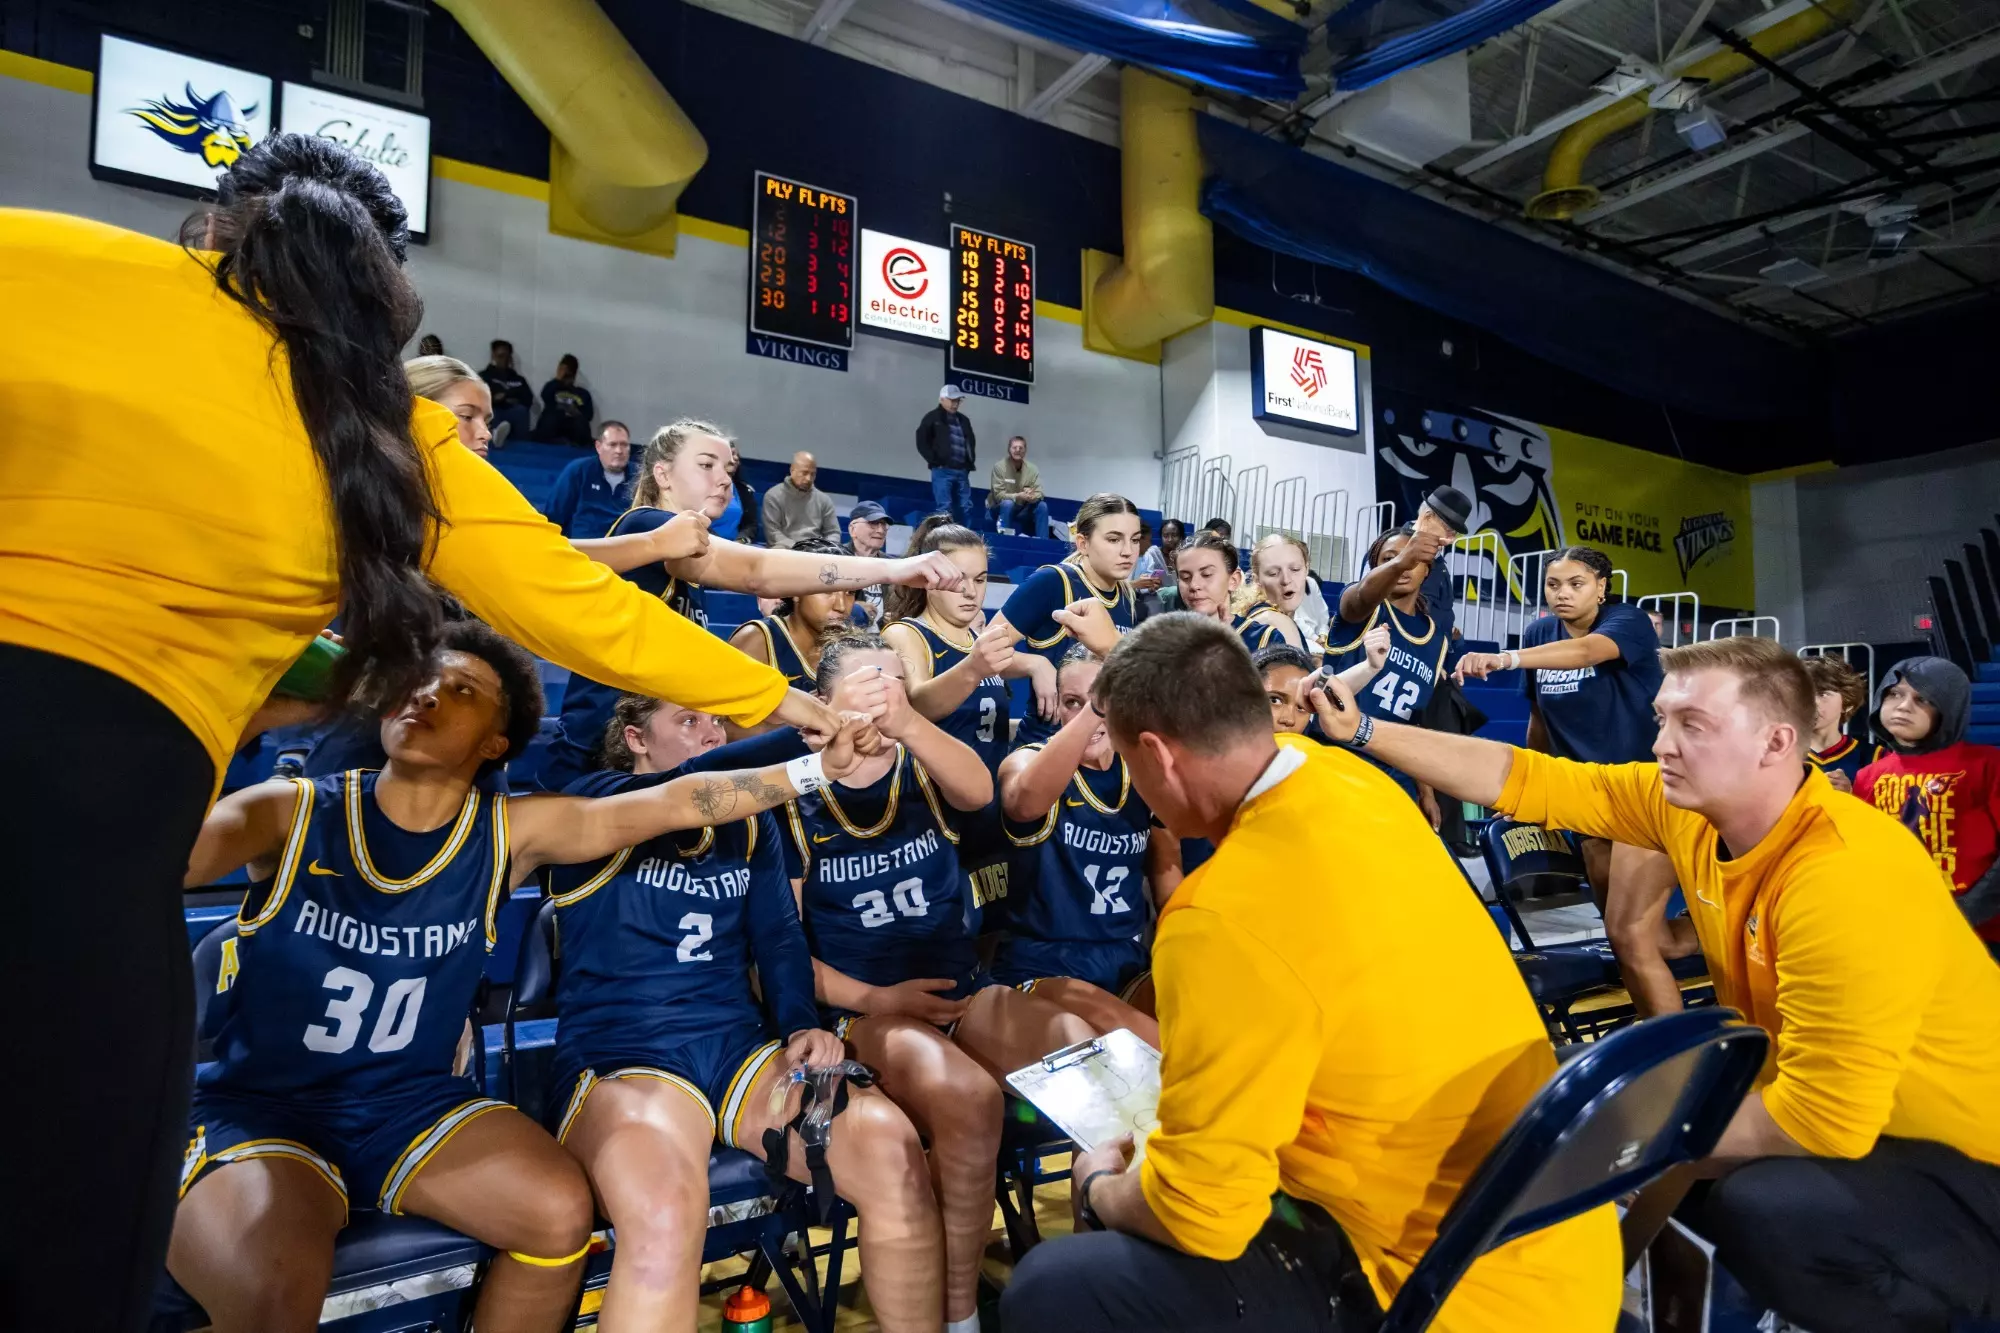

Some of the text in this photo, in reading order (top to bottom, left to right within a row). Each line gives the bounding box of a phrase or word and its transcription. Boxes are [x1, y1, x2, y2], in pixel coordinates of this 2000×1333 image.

[766, 179, 846, 214] PLY FL PTS
[809, 231, 818, 249] 3
[961, 230, 1026, 260] PLY FL PTS
[761, 243, 848, 278] 20 3 4
[962, 251, 1030, 280] 10 3 7
[761, 264, 848, 299] 23 3 7
[962, 270, 1030, 300] 13 2 10
[762, 287, 785, 309] 30
[831, 303, 849, 322] 13
[871, 298, 940, 325] electric
[962, 291, 1030, 320] 15 0 2
[864, 312, 928, 333] construction
[957, 307, 1030, 338] 20 2 14
[756, 338, 840, 368] VIKINGS
[957, 328, 1030, 360] 23 2 16
[961, 378, 1014, 400] GUEST
[1576, 502, 1660, 529] PUT ON YOUR
[1576, 519, 1663, 553] GAME FACE
[1675, 521, 1735, 574] VIKINGS
[1386, 645, 1433, 685] GUSTANA
[1371, 671, 1420, 721] 42
[1542, 683, 1578, 694] BASKETBALL
[820, 828, 939, 883] AUGUSTANA
[852, 876, 930, 928] 20
[1083, 863, 1131, 915] 12
[676, 911, 713, 963] 2
[302, 965, 427, 1054] 30
